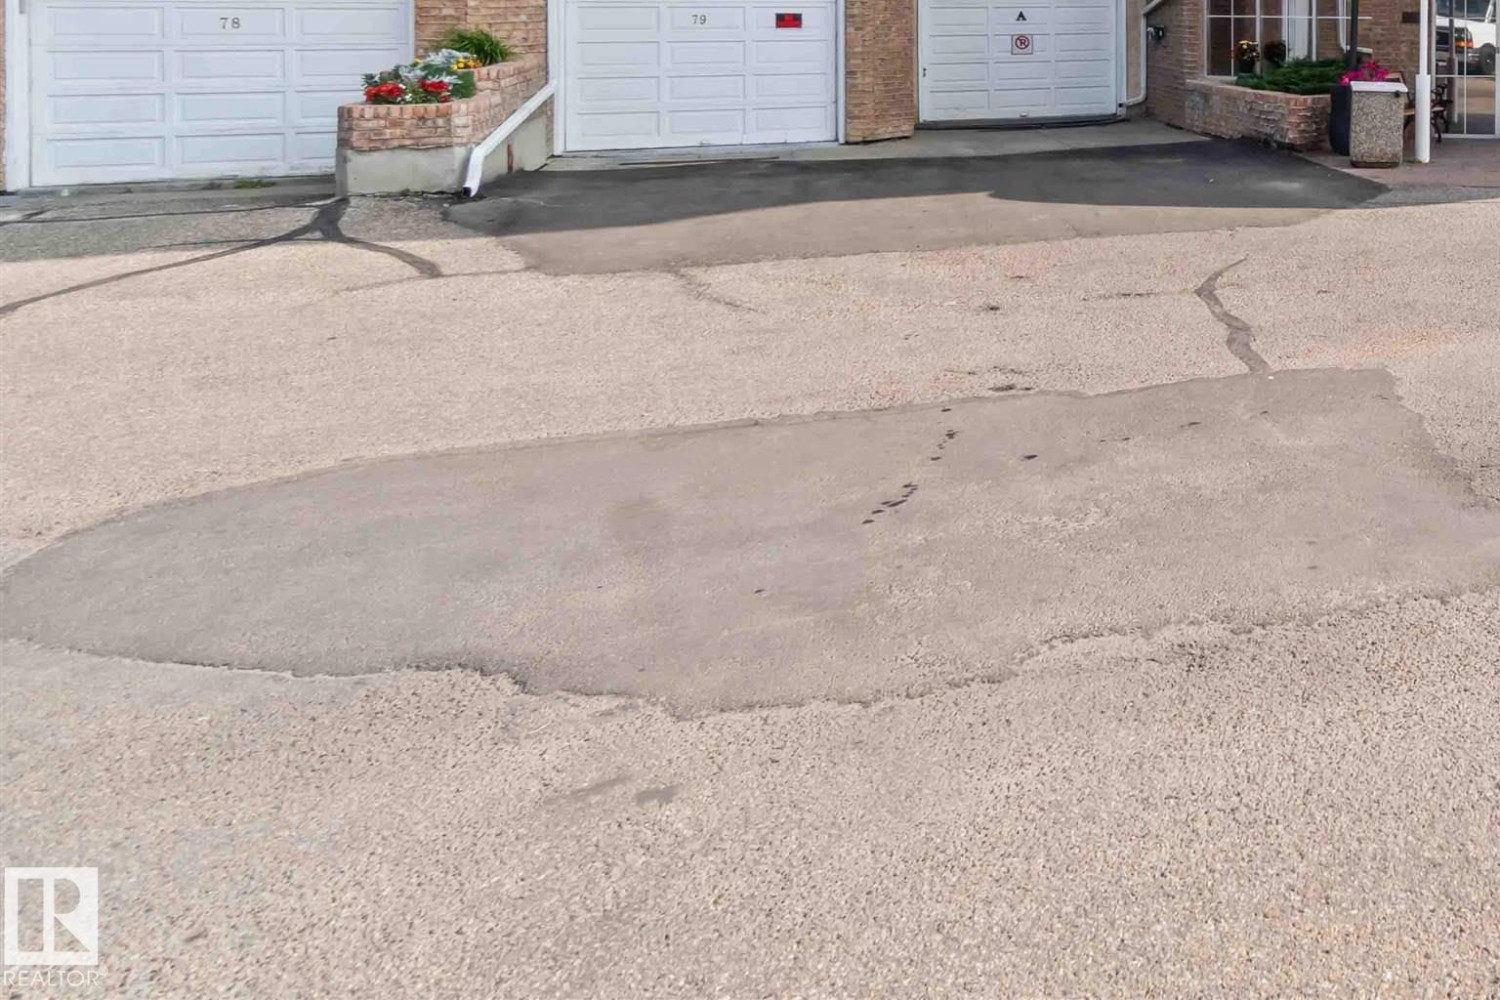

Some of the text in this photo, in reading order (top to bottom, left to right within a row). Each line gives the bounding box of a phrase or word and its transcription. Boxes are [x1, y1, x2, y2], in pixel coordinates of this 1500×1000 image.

[691, 14, 707, 25] 79
[1015, 10, 1027, 21] A
[219, 16, 241, 30] 78
